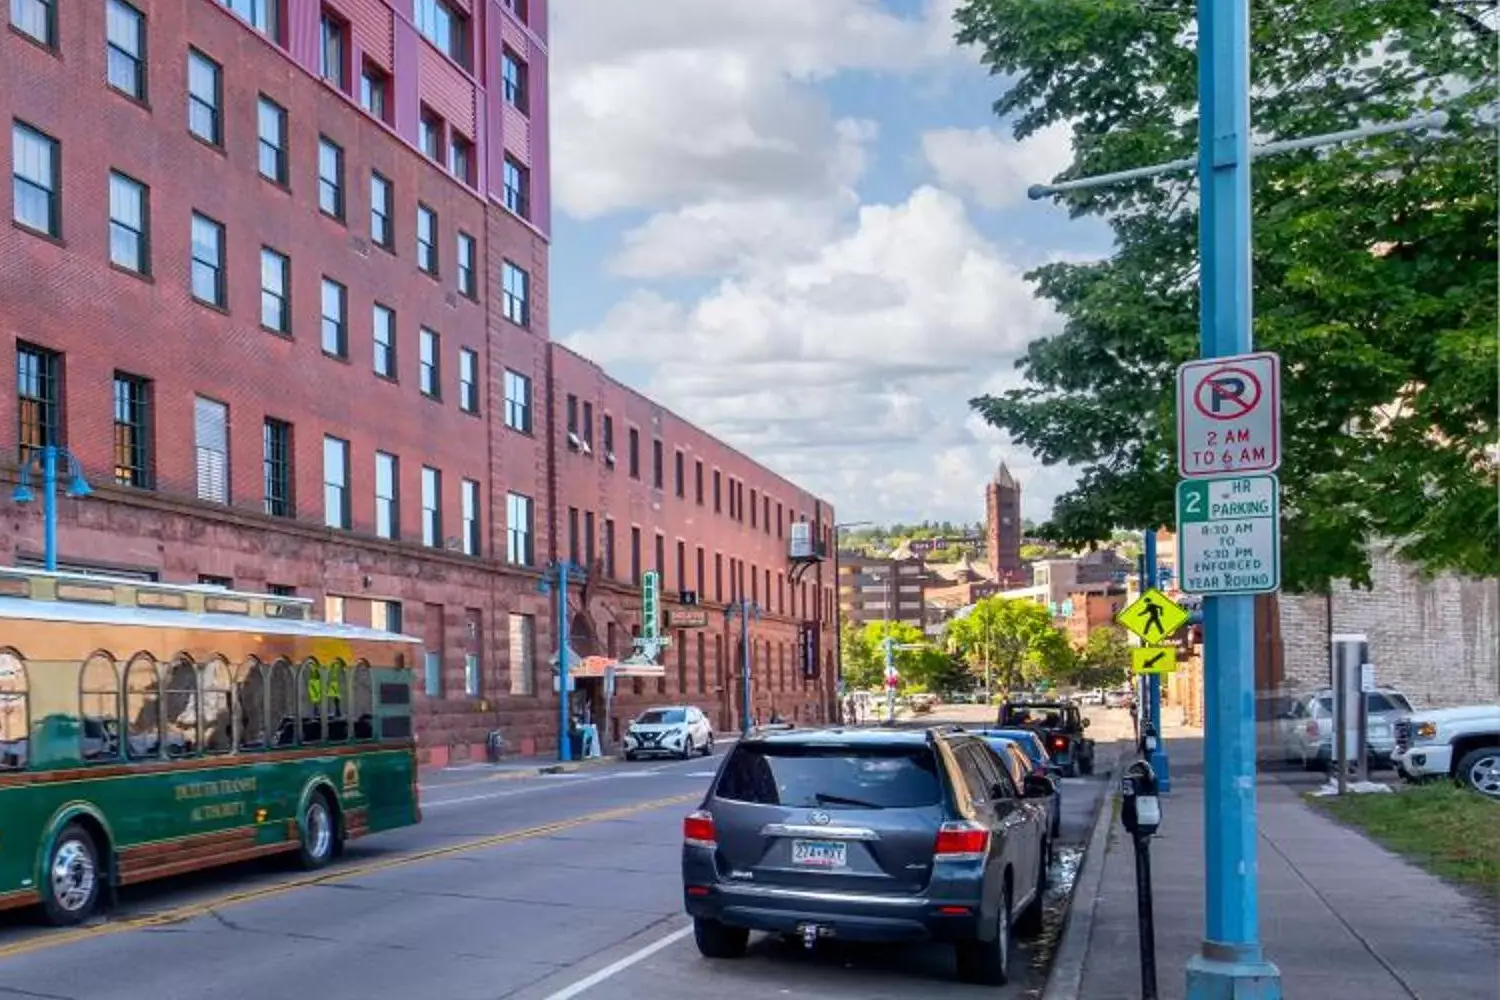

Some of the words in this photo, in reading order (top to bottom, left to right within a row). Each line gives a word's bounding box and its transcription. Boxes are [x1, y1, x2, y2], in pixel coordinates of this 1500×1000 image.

[1207, 431, 1218, 446] 2
[1225, 428, 1249, 445] AM
[1193, 450, 1215, 466] TO
[1222, 449, 1233, 464] 6
[1240, 446, 1265, 462] AM
[1233, 480, 1251, 493] HR
[1186, 491, 1201, 513] 2
[1212, 499, 1269, 517] PARKING
[1236, 523, 1253, 534] AM
[1220, 536, 1235, 547] TO
[1204, 549, 1229, 560] 5:30
[1236, 547, 1253, 558] PM
[1194, 560, 1261, 573] ENFORCED
[1188, 575, 1218, 589] YEAR
[1225, 573, 1269, 587] ROUND
